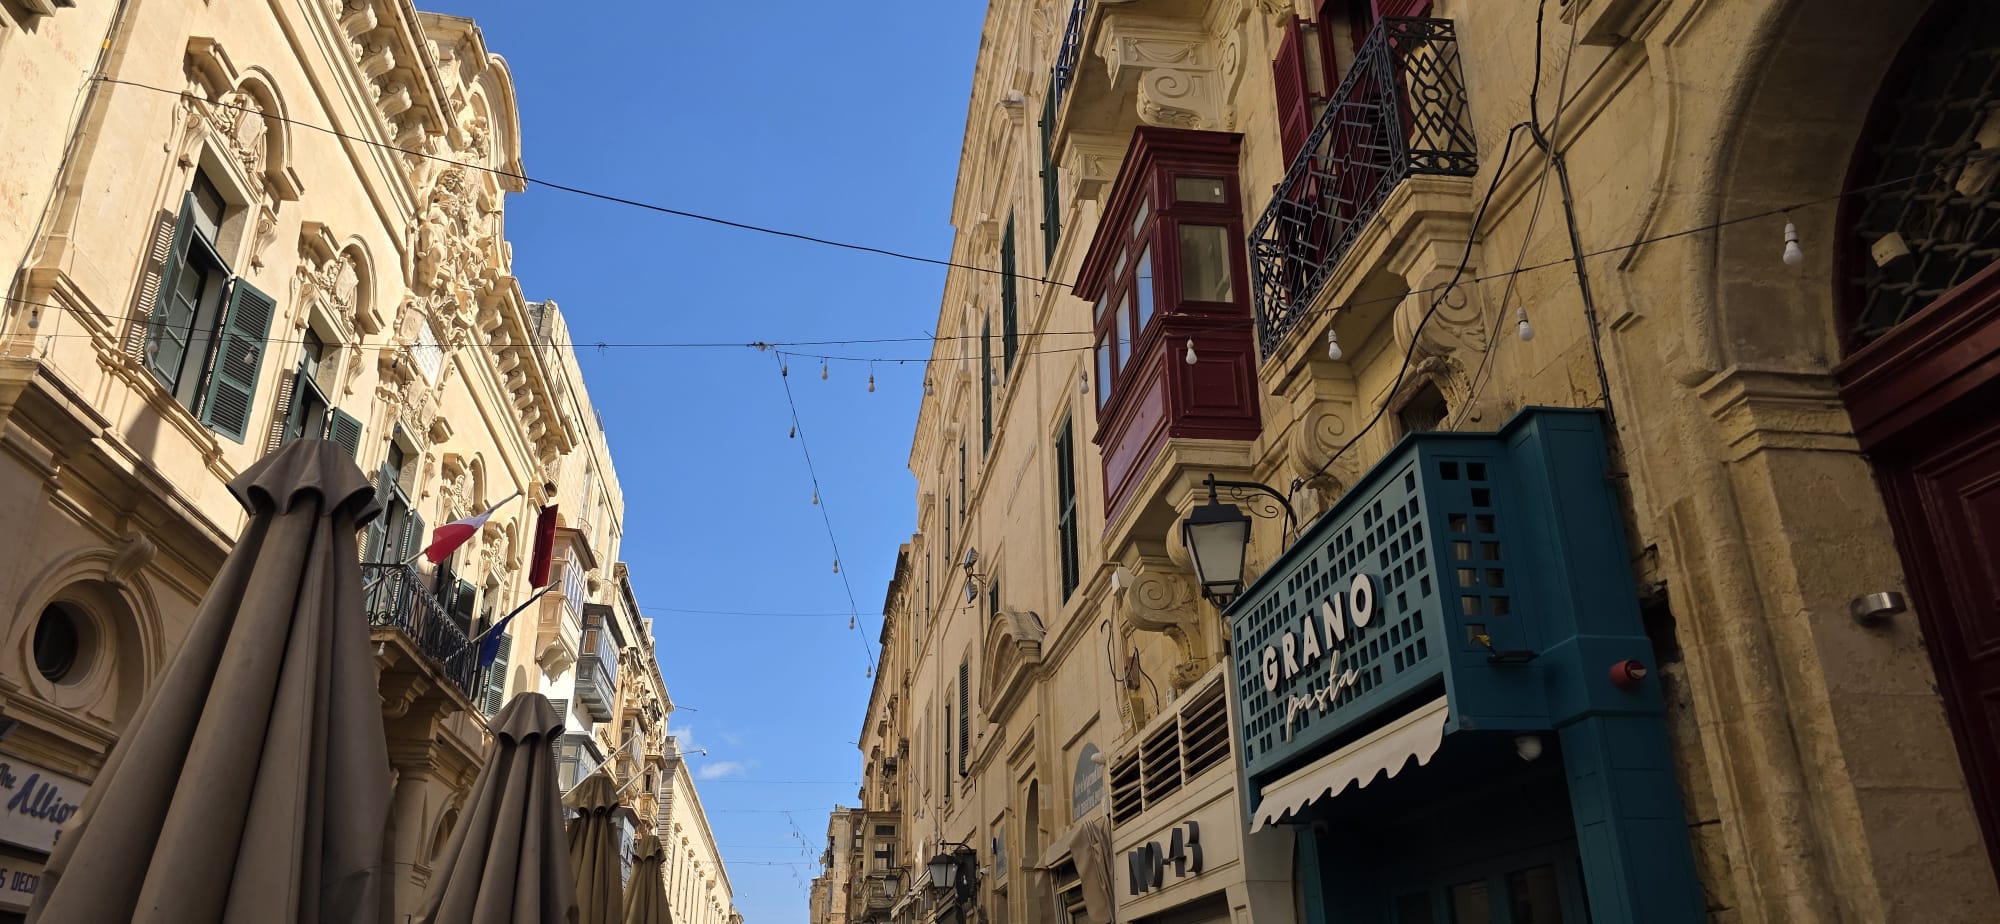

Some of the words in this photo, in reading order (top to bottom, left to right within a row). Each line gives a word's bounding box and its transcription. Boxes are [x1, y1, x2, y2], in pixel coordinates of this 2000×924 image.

[1263, 573, 1376, 692] GRANO
[1286, 650, 1362, 743] pasta
[1128, 820, 1203, 896] NO-43
